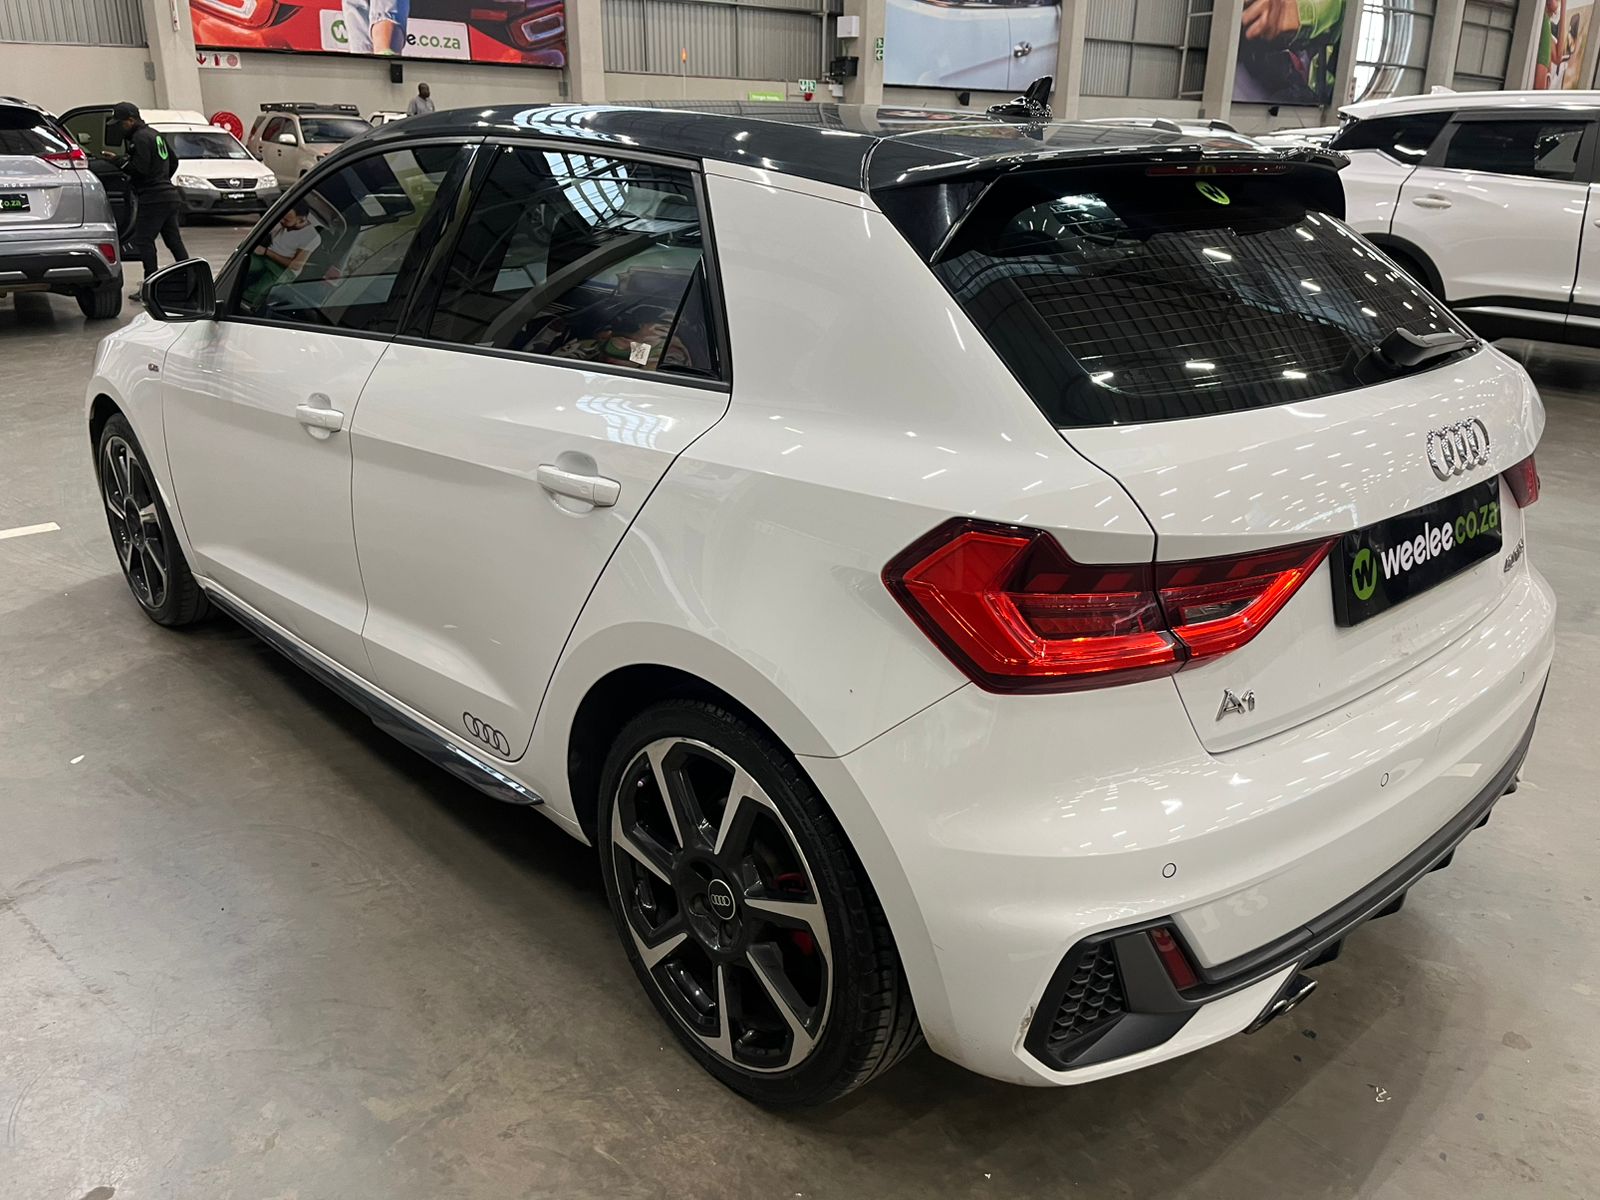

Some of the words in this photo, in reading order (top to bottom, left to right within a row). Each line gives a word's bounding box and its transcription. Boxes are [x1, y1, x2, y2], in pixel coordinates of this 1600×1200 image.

[406, 33, 461, 50] e.co.za
[1380, 501, 1498, 580] weelee.co.za
[1215, 687, 1255, 722] A1
